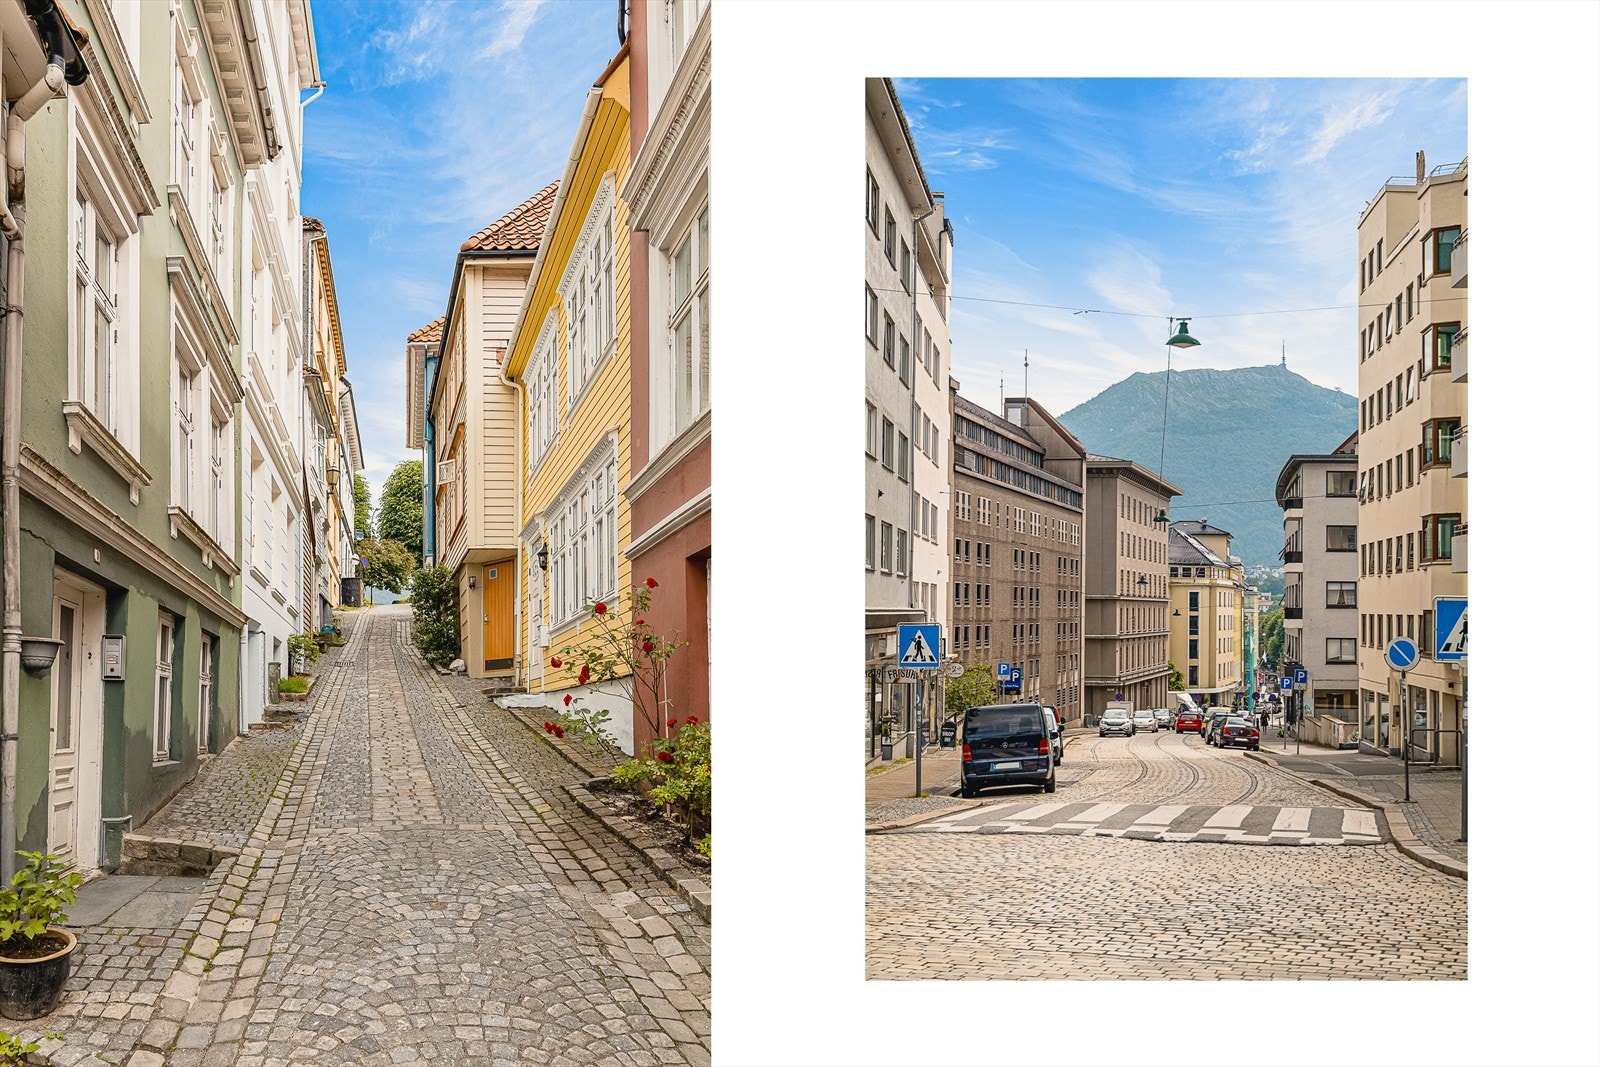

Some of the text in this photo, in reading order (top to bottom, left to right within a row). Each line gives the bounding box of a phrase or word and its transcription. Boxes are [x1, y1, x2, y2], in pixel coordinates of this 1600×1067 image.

[1001, 664, 1008, 674] P
[1012, 672, 1020, 682] P
[1298, 671, 1305, 682] P
[1283, 679, 1290, 688] P
